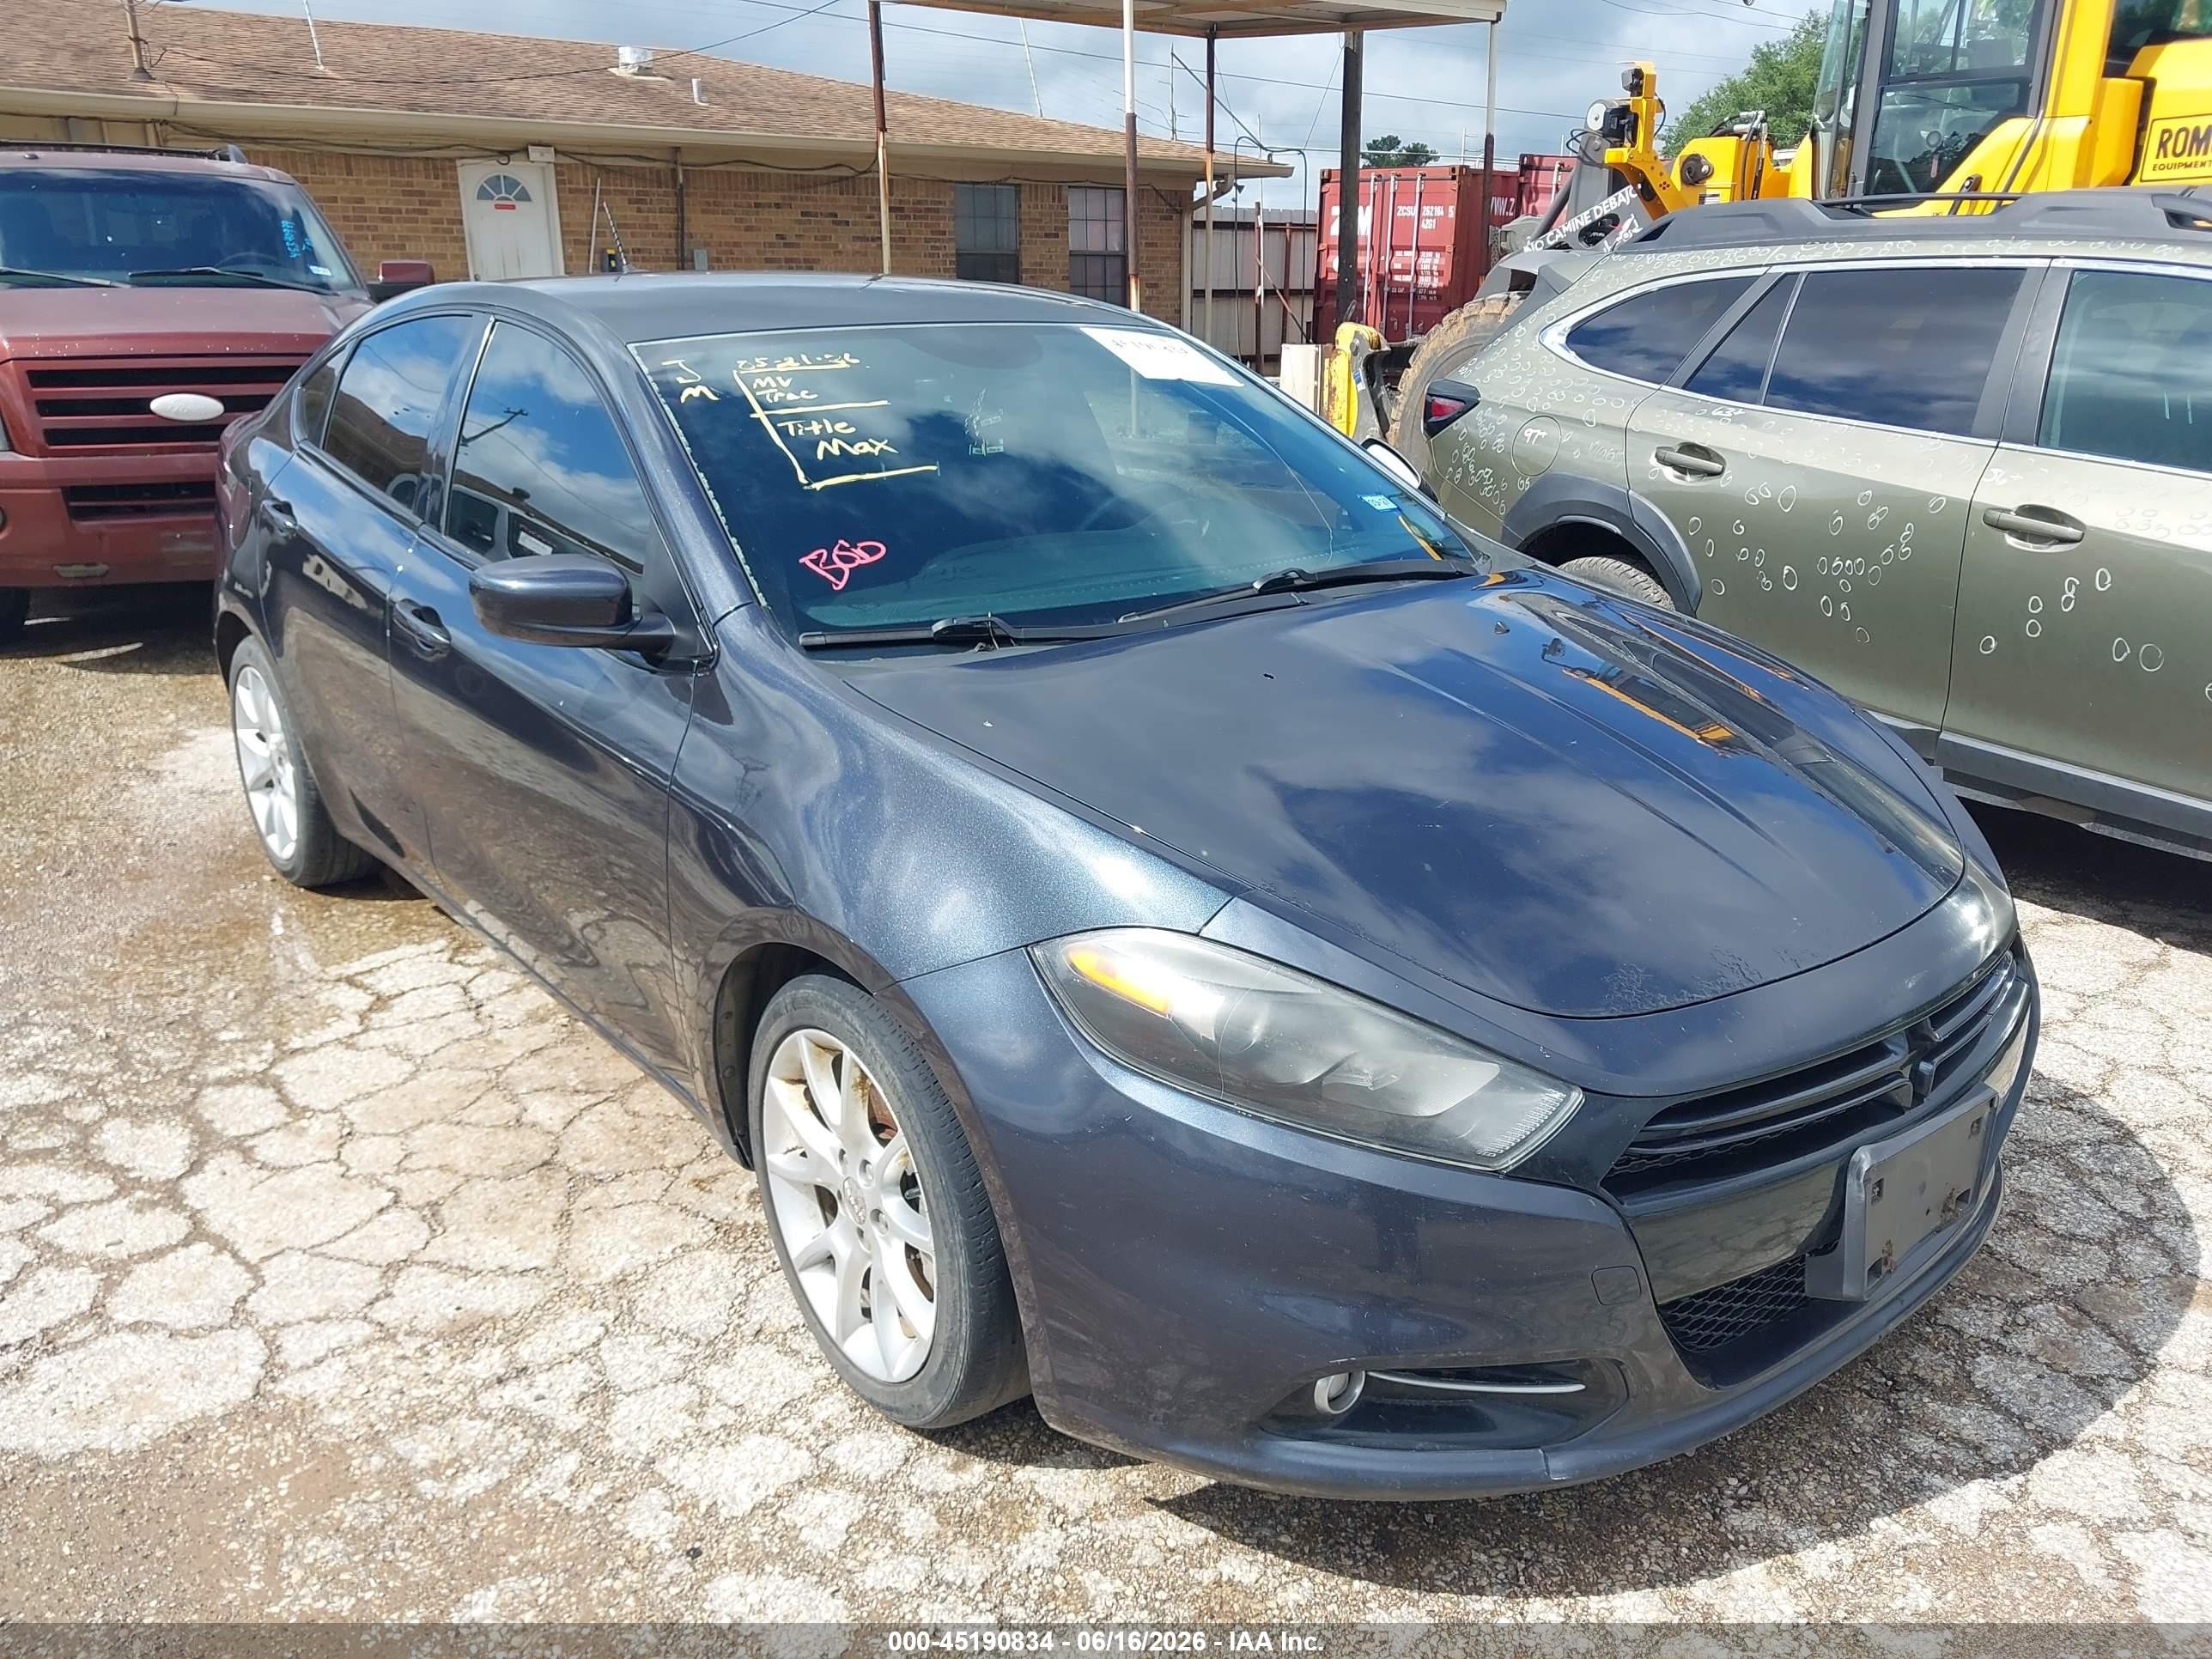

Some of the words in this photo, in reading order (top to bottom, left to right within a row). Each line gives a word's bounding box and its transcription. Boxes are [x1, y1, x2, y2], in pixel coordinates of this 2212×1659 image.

[2155, 125, 2212, 160] ROM
[1396, 205, 1416, 217] ZCSU
[1547, 210, 1591, 245] CAMINE
[776, 419, 856, 437] Title
[817, 438, 899, 460] Max
